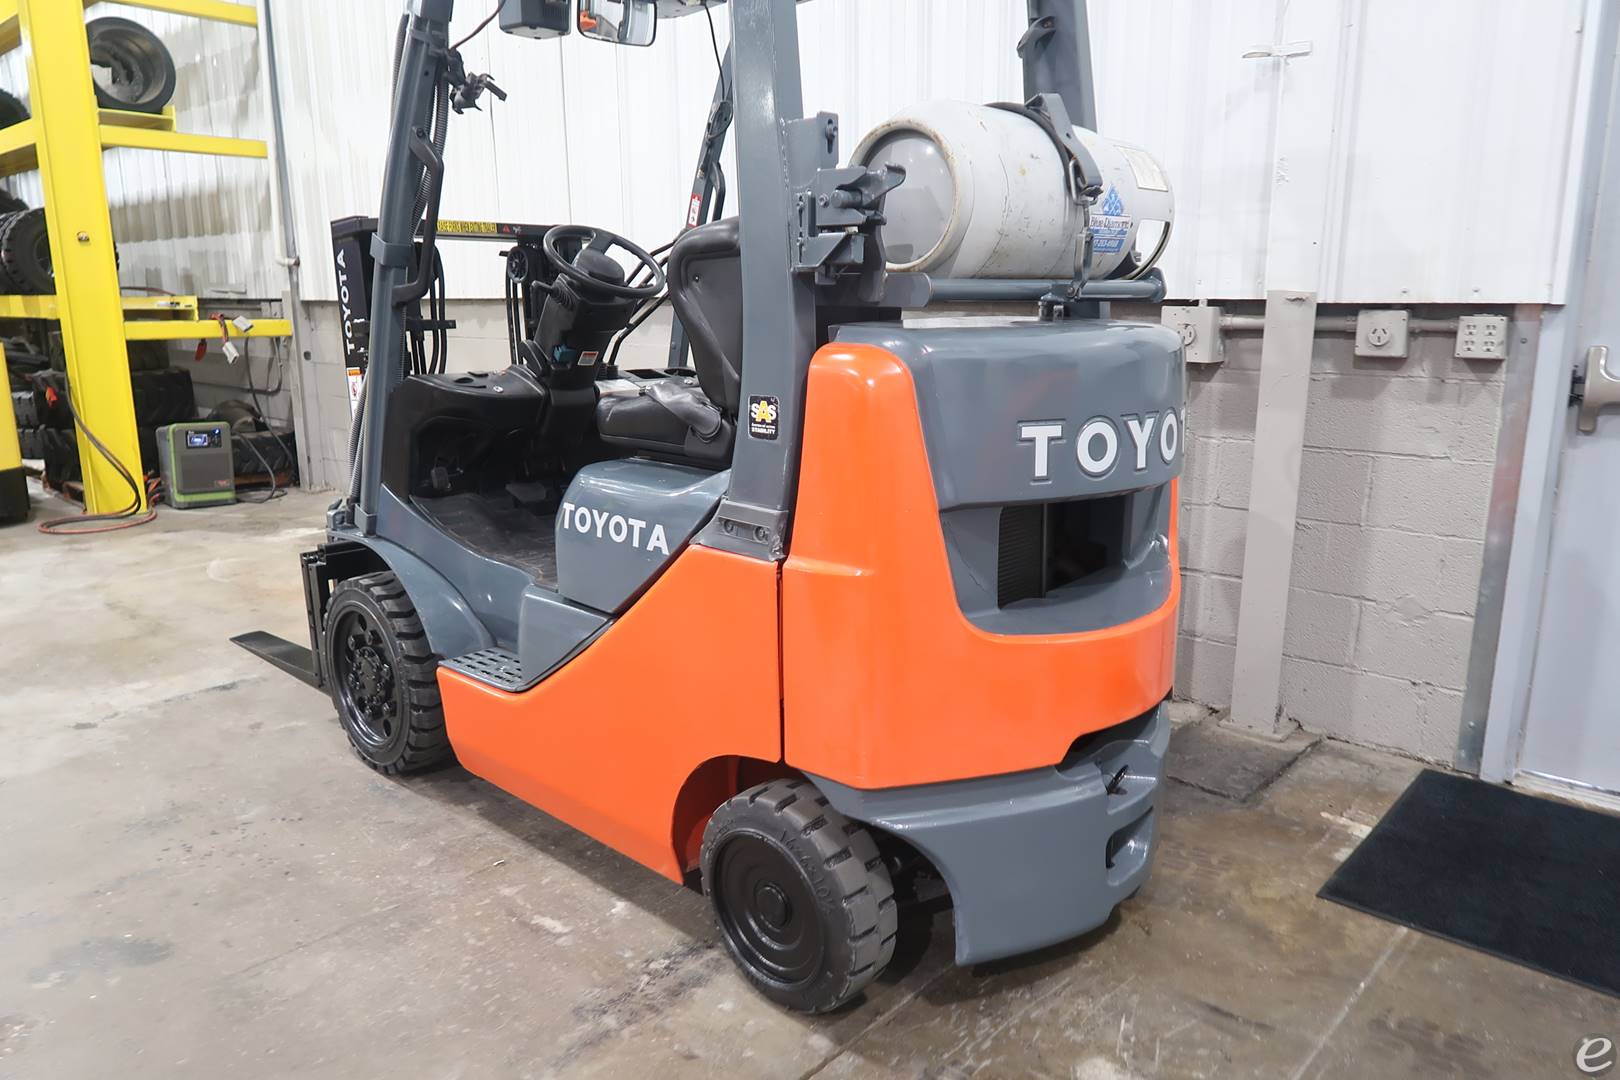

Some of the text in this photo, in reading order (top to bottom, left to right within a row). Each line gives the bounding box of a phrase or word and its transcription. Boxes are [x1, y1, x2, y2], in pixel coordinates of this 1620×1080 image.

[336, 248, 356, 356] TOYOTA
[751, 400, 777, 423] SAS
[563, 502, 669, 556] TOYOTA
